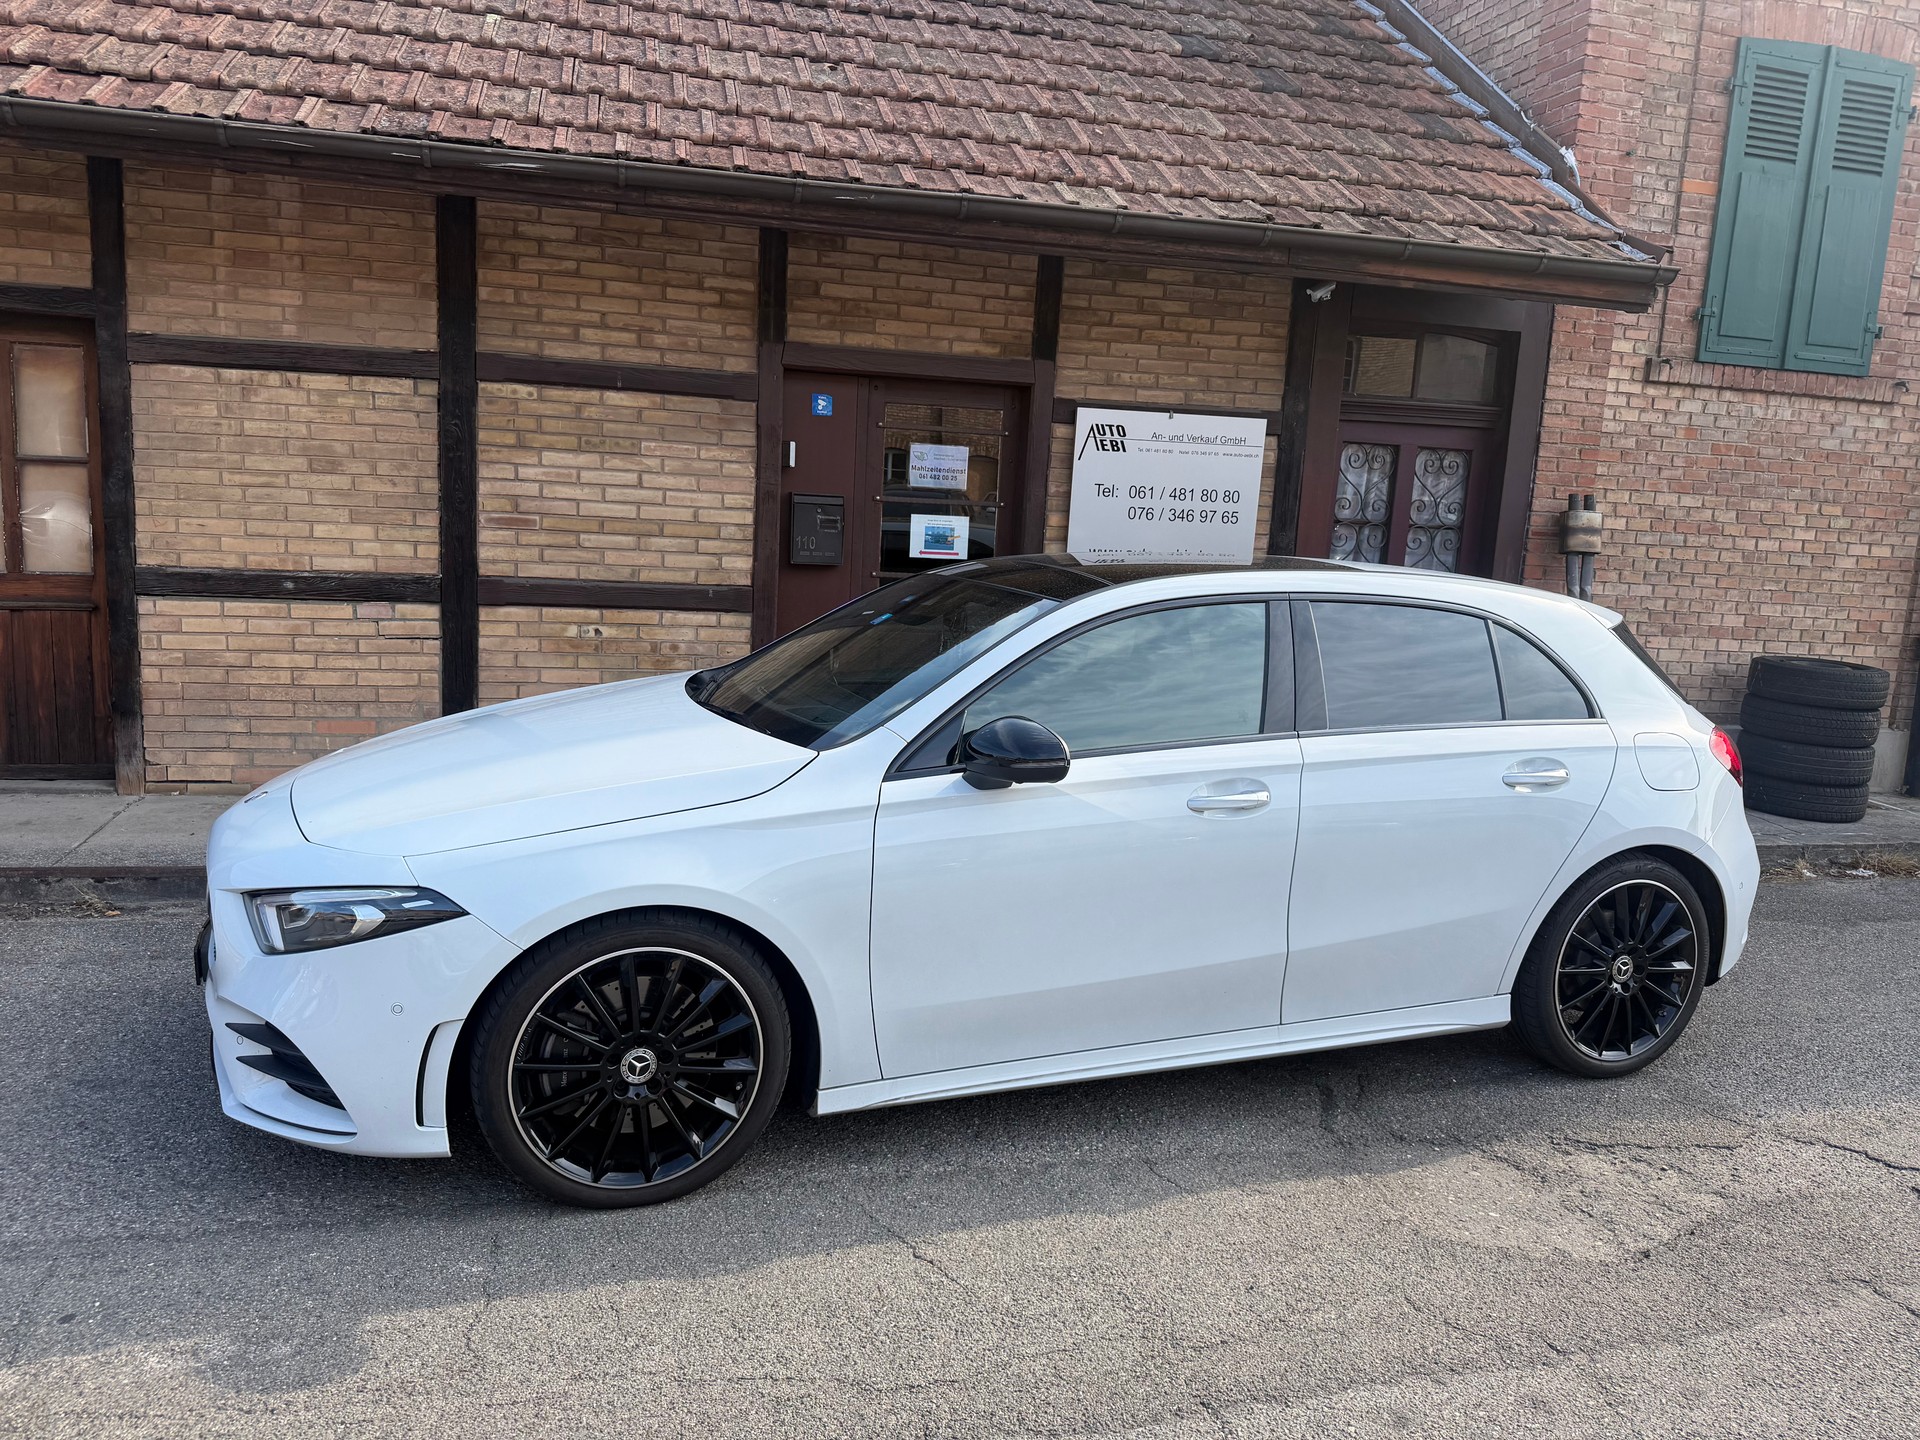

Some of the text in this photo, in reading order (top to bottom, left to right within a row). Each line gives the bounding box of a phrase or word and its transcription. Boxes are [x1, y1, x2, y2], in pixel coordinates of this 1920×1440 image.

[1151, 432, 1247, 445] An- und Verkauf GmbH
[911, 464, 967, 475] Mahlzeitendienst
[1094, 483, 1240, 504] Tel: 061 / 481 80 80
[1127, 506, 1239, 525] 076 / 346 97 65
[795, 535, 816, 550] 110
